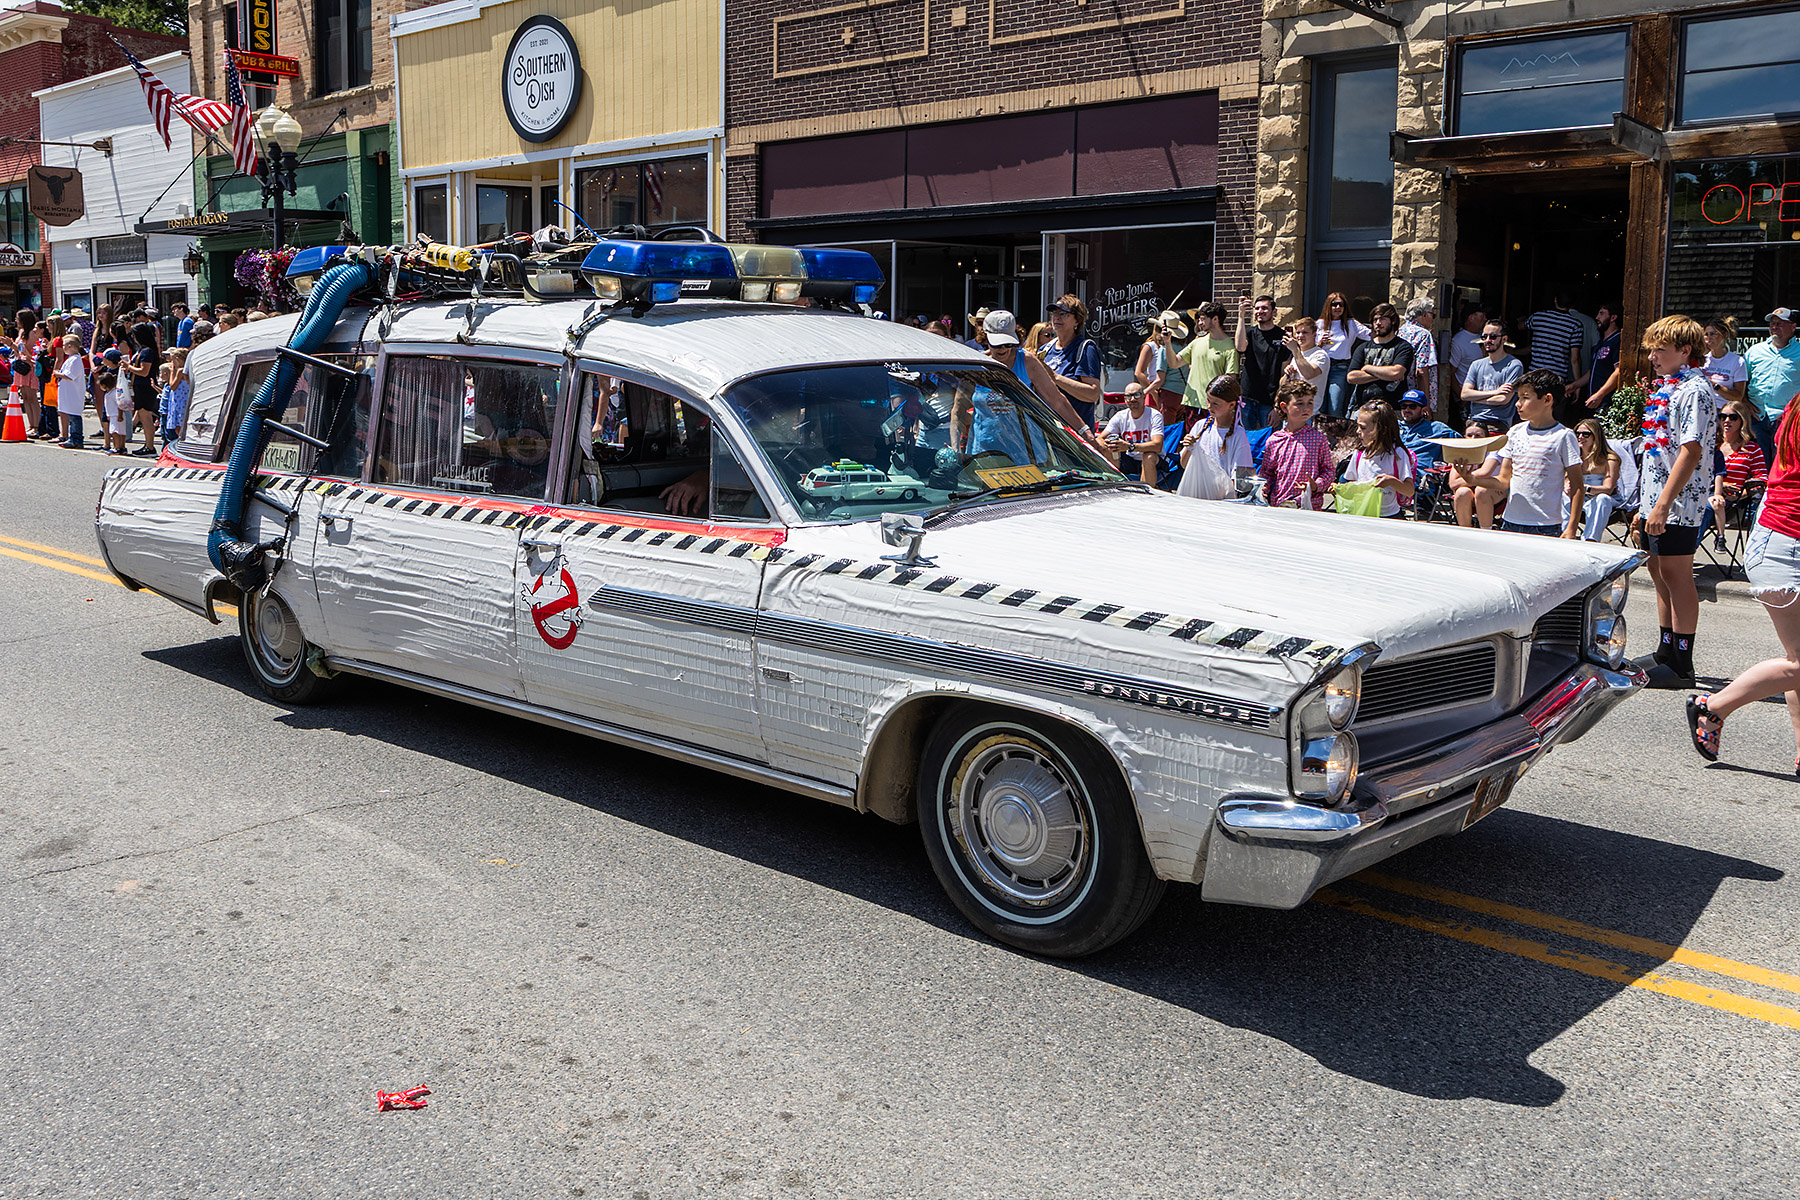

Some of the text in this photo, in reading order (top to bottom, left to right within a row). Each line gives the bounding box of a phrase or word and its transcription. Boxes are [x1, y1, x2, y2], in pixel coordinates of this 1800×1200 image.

[539, 38, 549, 46] 2021
[234, 54, 297, 72] PUB & GRILL
[513, 52, 566, 86] SOUTHERN
[526, 78, 555, 109] DISH
[520, 111, 541, 126] KITCHEN
[546, 106, 560, 122] HOME
[51, 206, 82, 214] MONTANA
[167, 218, 193, 229] FOSTER
[193, 215, 199, 226] &
[1105, 281, 1154, 307] RED LODGE
[1091, 296, 1159, 333] JEWELERS
[436, 463, 489, 482] AMBULANCE
[1083, 680, 1252, 721] BONNEVILLE
